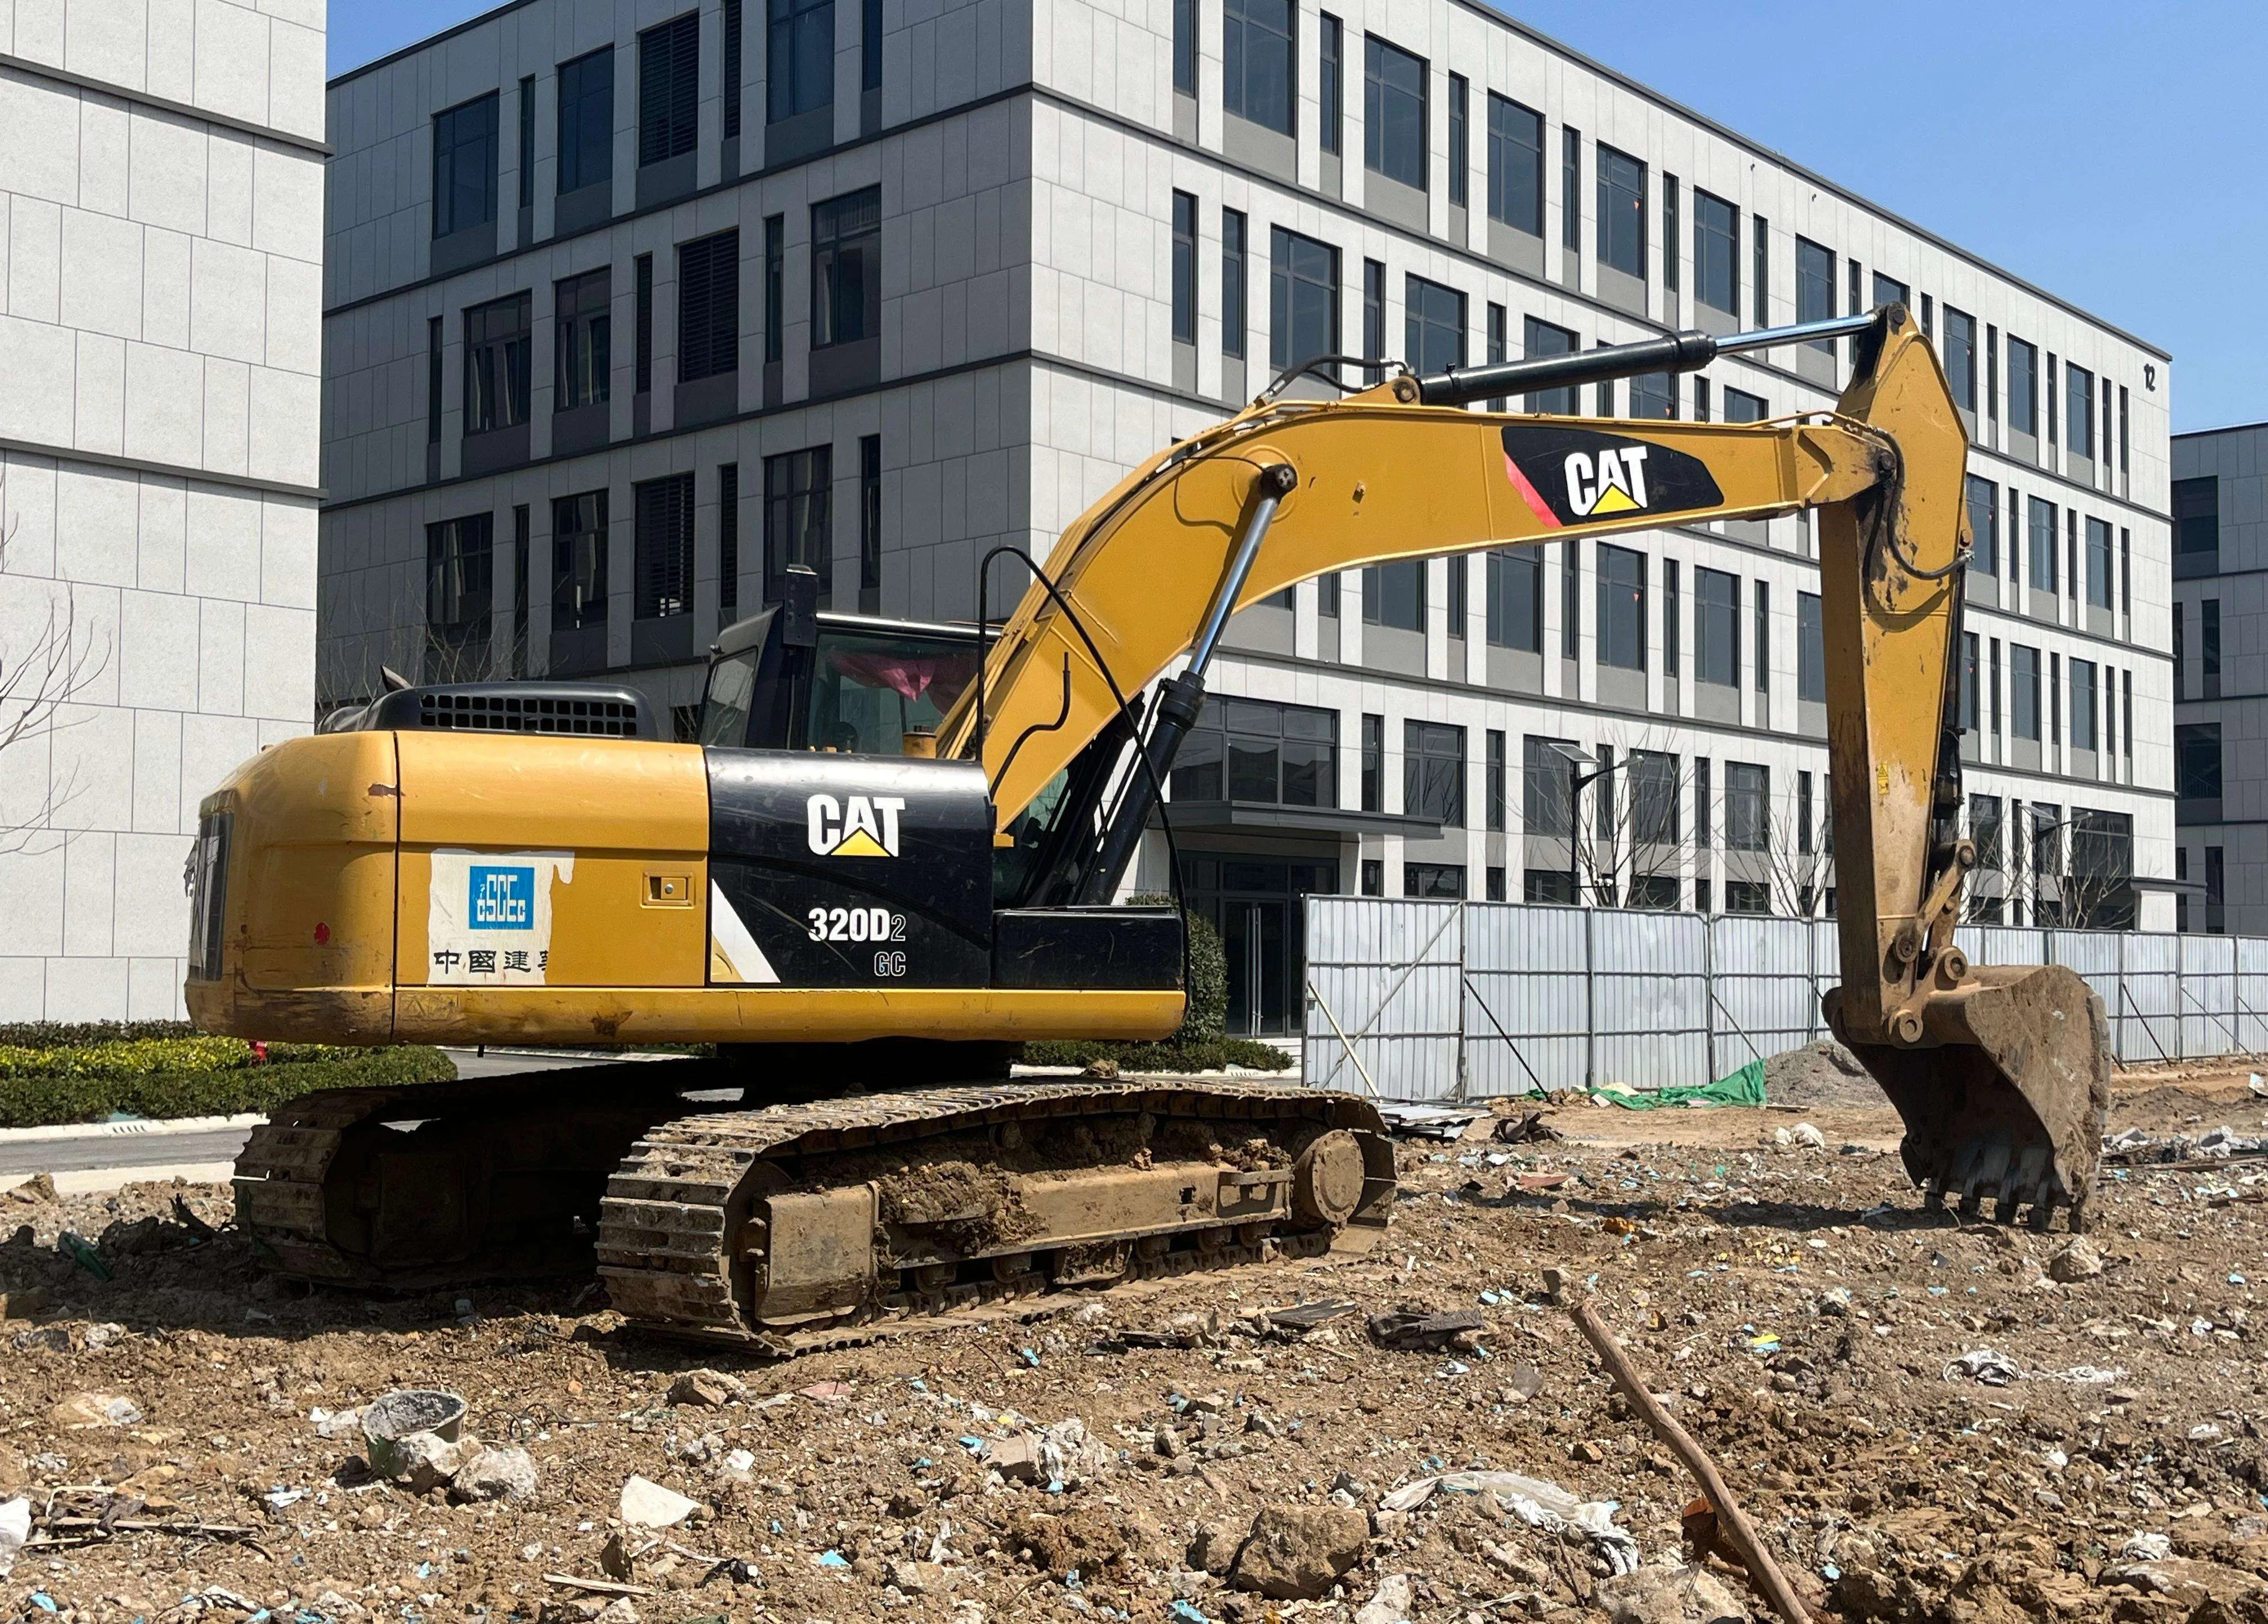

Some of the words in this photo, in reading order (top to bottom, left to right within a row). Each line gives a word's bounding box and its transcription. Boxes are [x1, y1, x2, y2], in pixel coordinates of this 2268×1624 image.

[2144, 363, 2156, 392] 12
[1564, 446, 1648, 516] CAT
[807, 794, 905, 857] CAT
[808, 908, 906, 942] 320D2
[874, 952, 906, 977] GC
